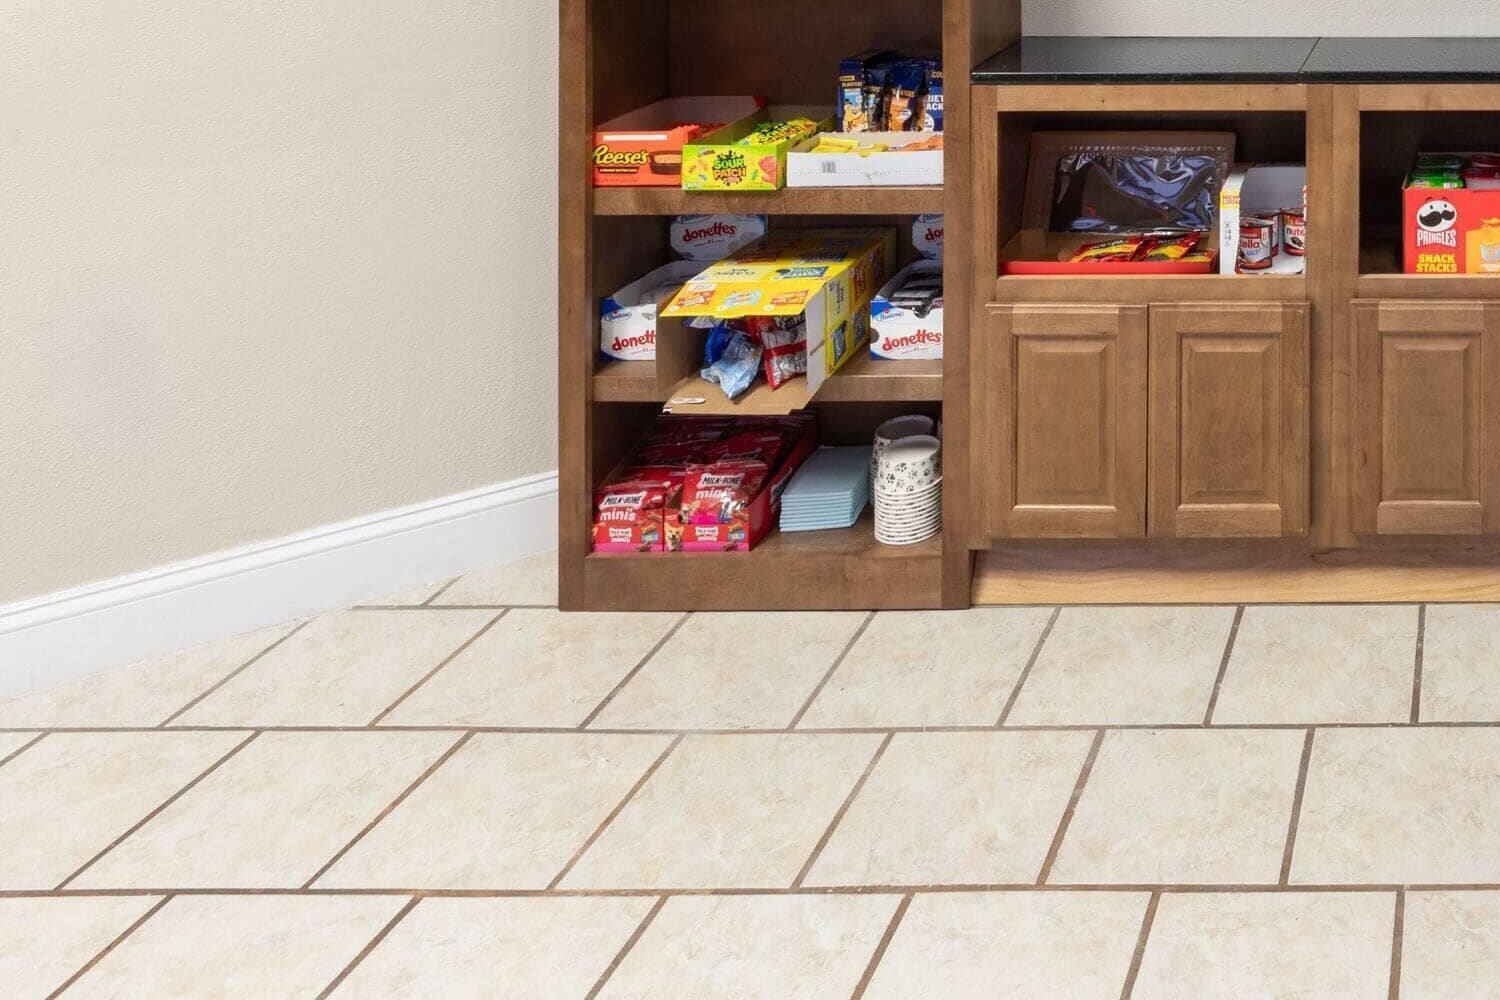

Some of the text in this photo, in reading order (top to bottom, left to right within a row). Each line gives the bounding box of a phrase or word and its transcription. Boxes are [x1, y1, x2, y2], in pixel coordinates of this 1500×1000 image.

[926, 102, 943, 111] ACK
[592, 144, 649, 165] Reese's
[714, 158, 745, 169] SOUR
[713, 167, 747, 180] PATCH
[683, 222, 737, 243] donettes
[925, 228, 943, 241] do
[1286, 227, 1305, 237] nute
[1416, 229, 1457, 248] PRINGLES
[1418, 254, 1456, 264] SNACK
[1416, 263, 1457, 273] STACKS
[612, 330, 656, 351] donett
[882, 329, 942, 352] donettes
[701, 475, 741, 485] MILK-BONE
[604, 494, 642, 506] MILK-BONE
